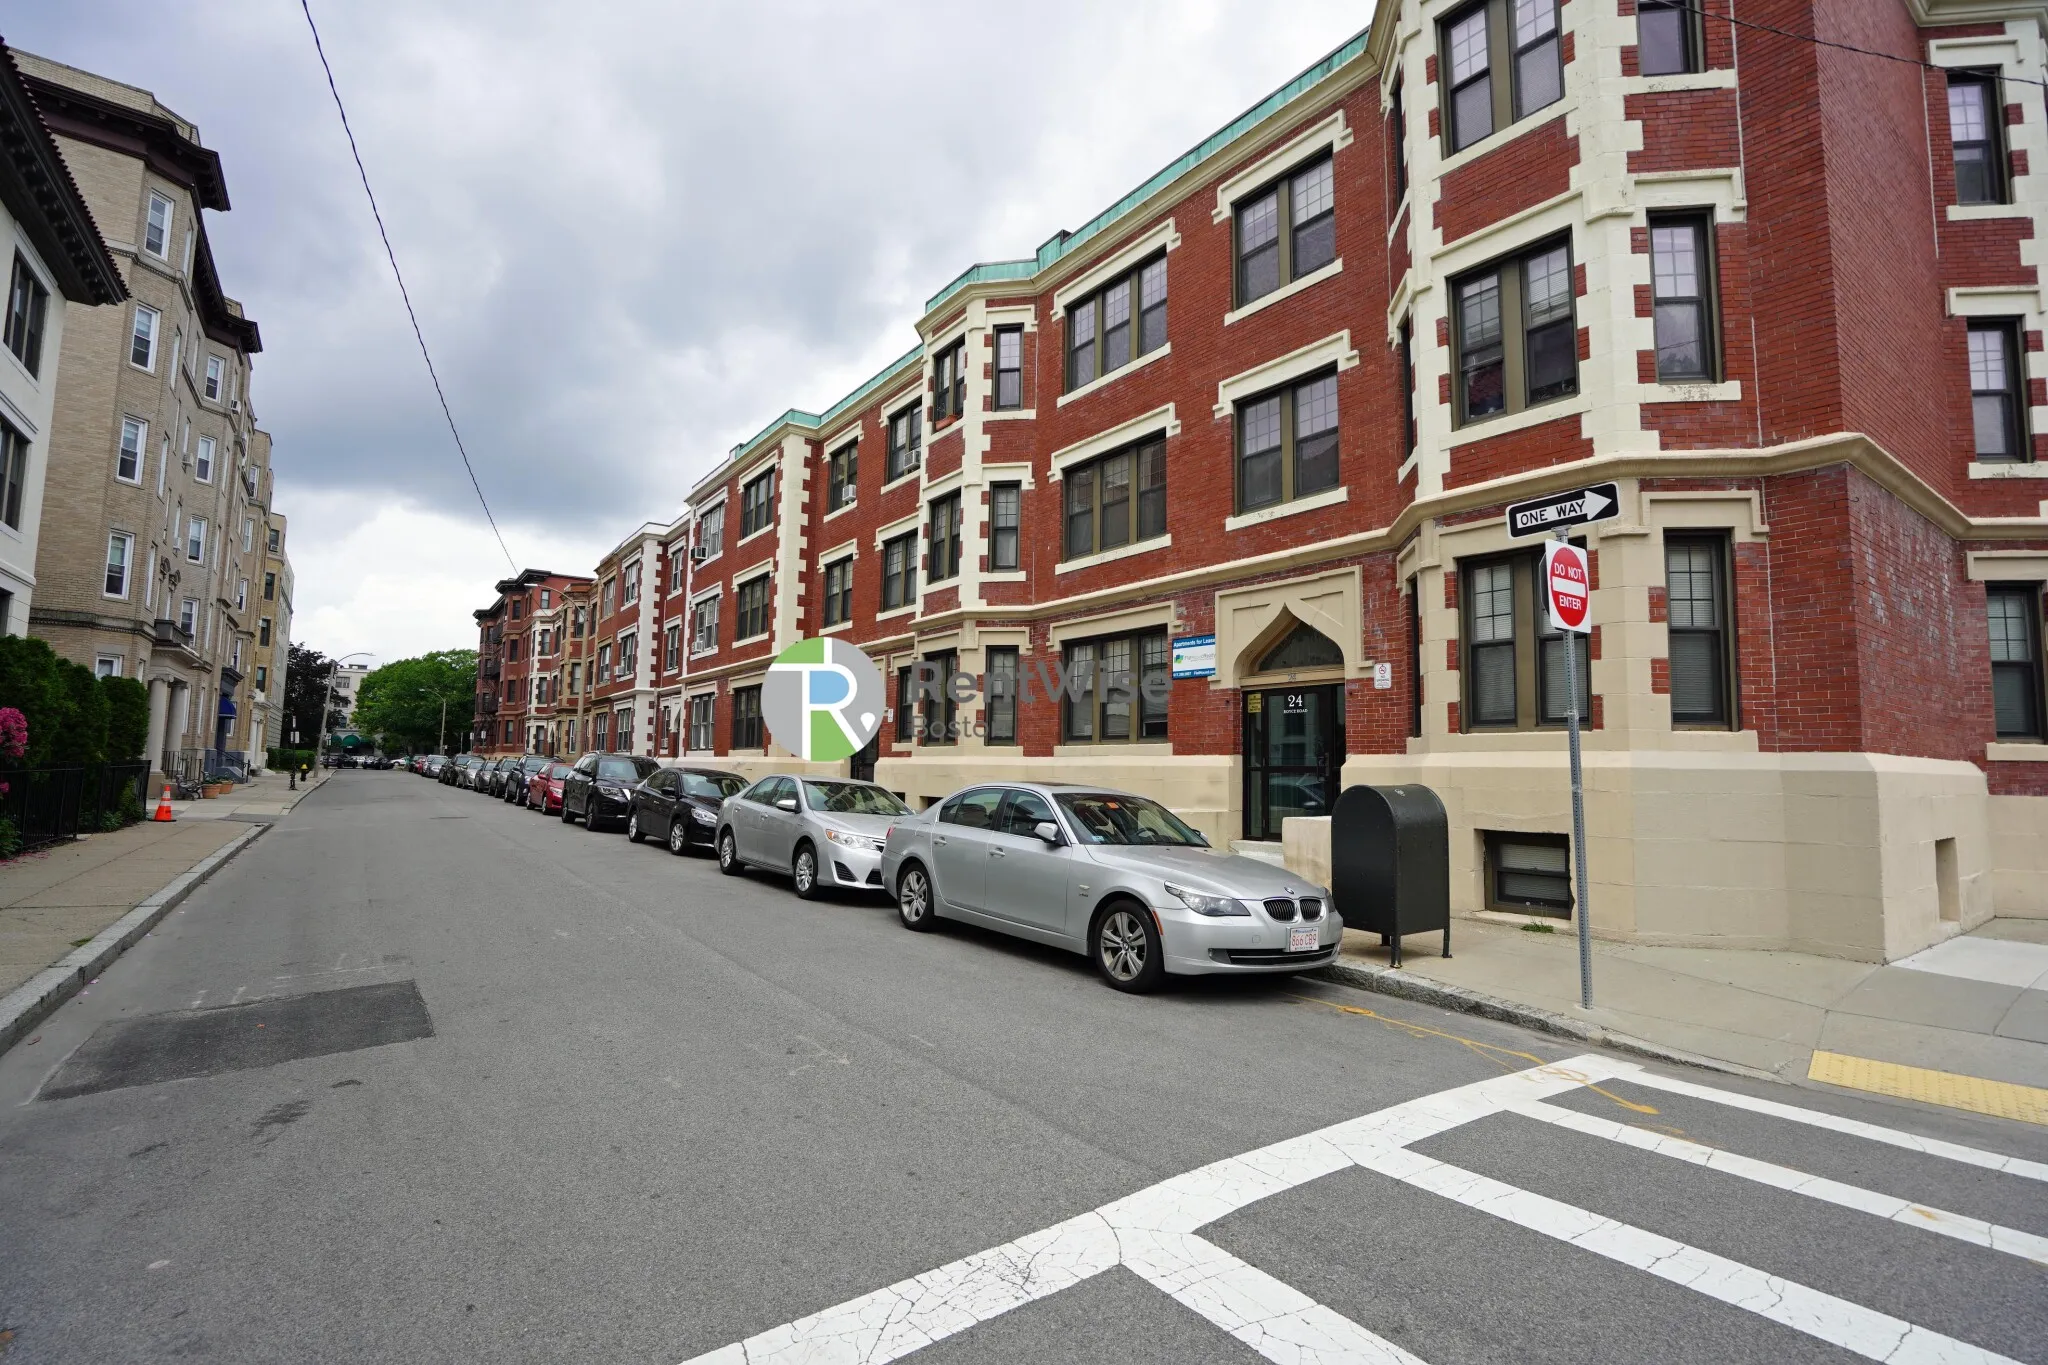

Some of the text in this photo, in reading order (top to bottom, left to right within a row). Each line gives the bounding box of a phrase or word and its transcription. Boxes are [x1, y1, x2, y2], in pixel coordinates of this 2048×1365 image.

[1520, 500, 1585, 526] ONE WAY
[1554, 562, 1582, 579] DO NOT
[1559, 595, 1582, 610] ENTER
[1173, 640, 1196, 648] Apartments
[1287, 694, 1303, 707] 24
